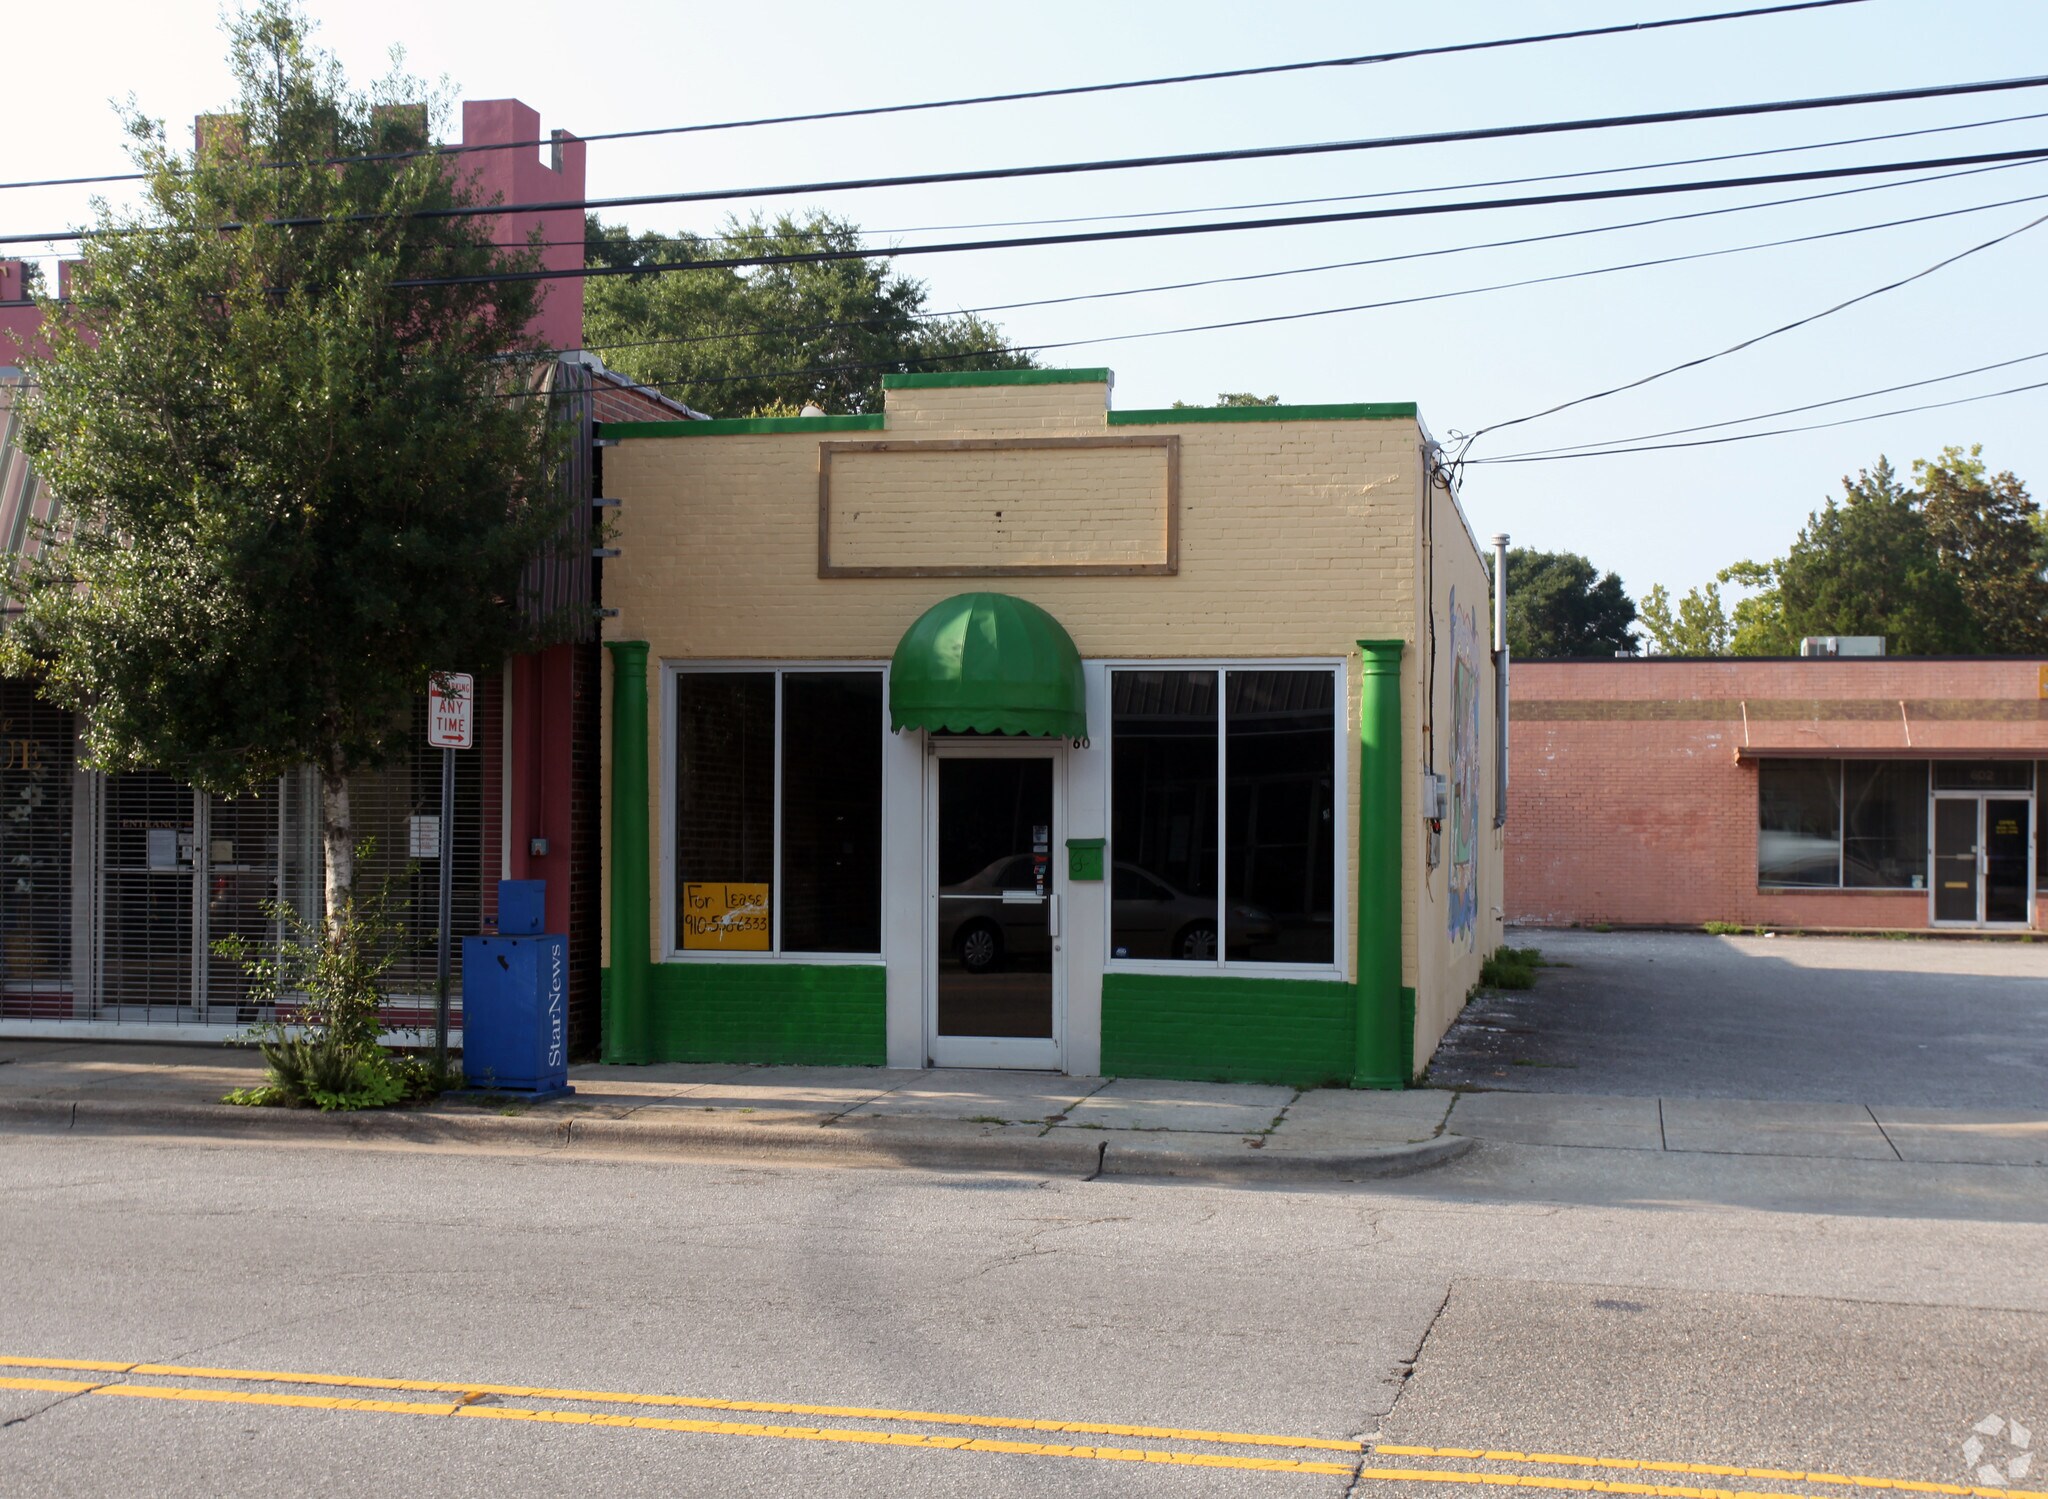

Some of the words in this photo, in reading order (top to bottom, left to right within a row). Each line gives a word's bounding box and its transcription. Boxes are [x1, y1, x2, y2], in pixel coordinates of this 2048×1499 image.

[445, 683, 470, 693] ARKING
[439, 700, 464, 715] ANY
[437, 717, 465, 732] TIME
[687, 884, 714, 909] For
[724, 885, 762, 909] Lease
[549, 944, 561, 1067] StarNews
